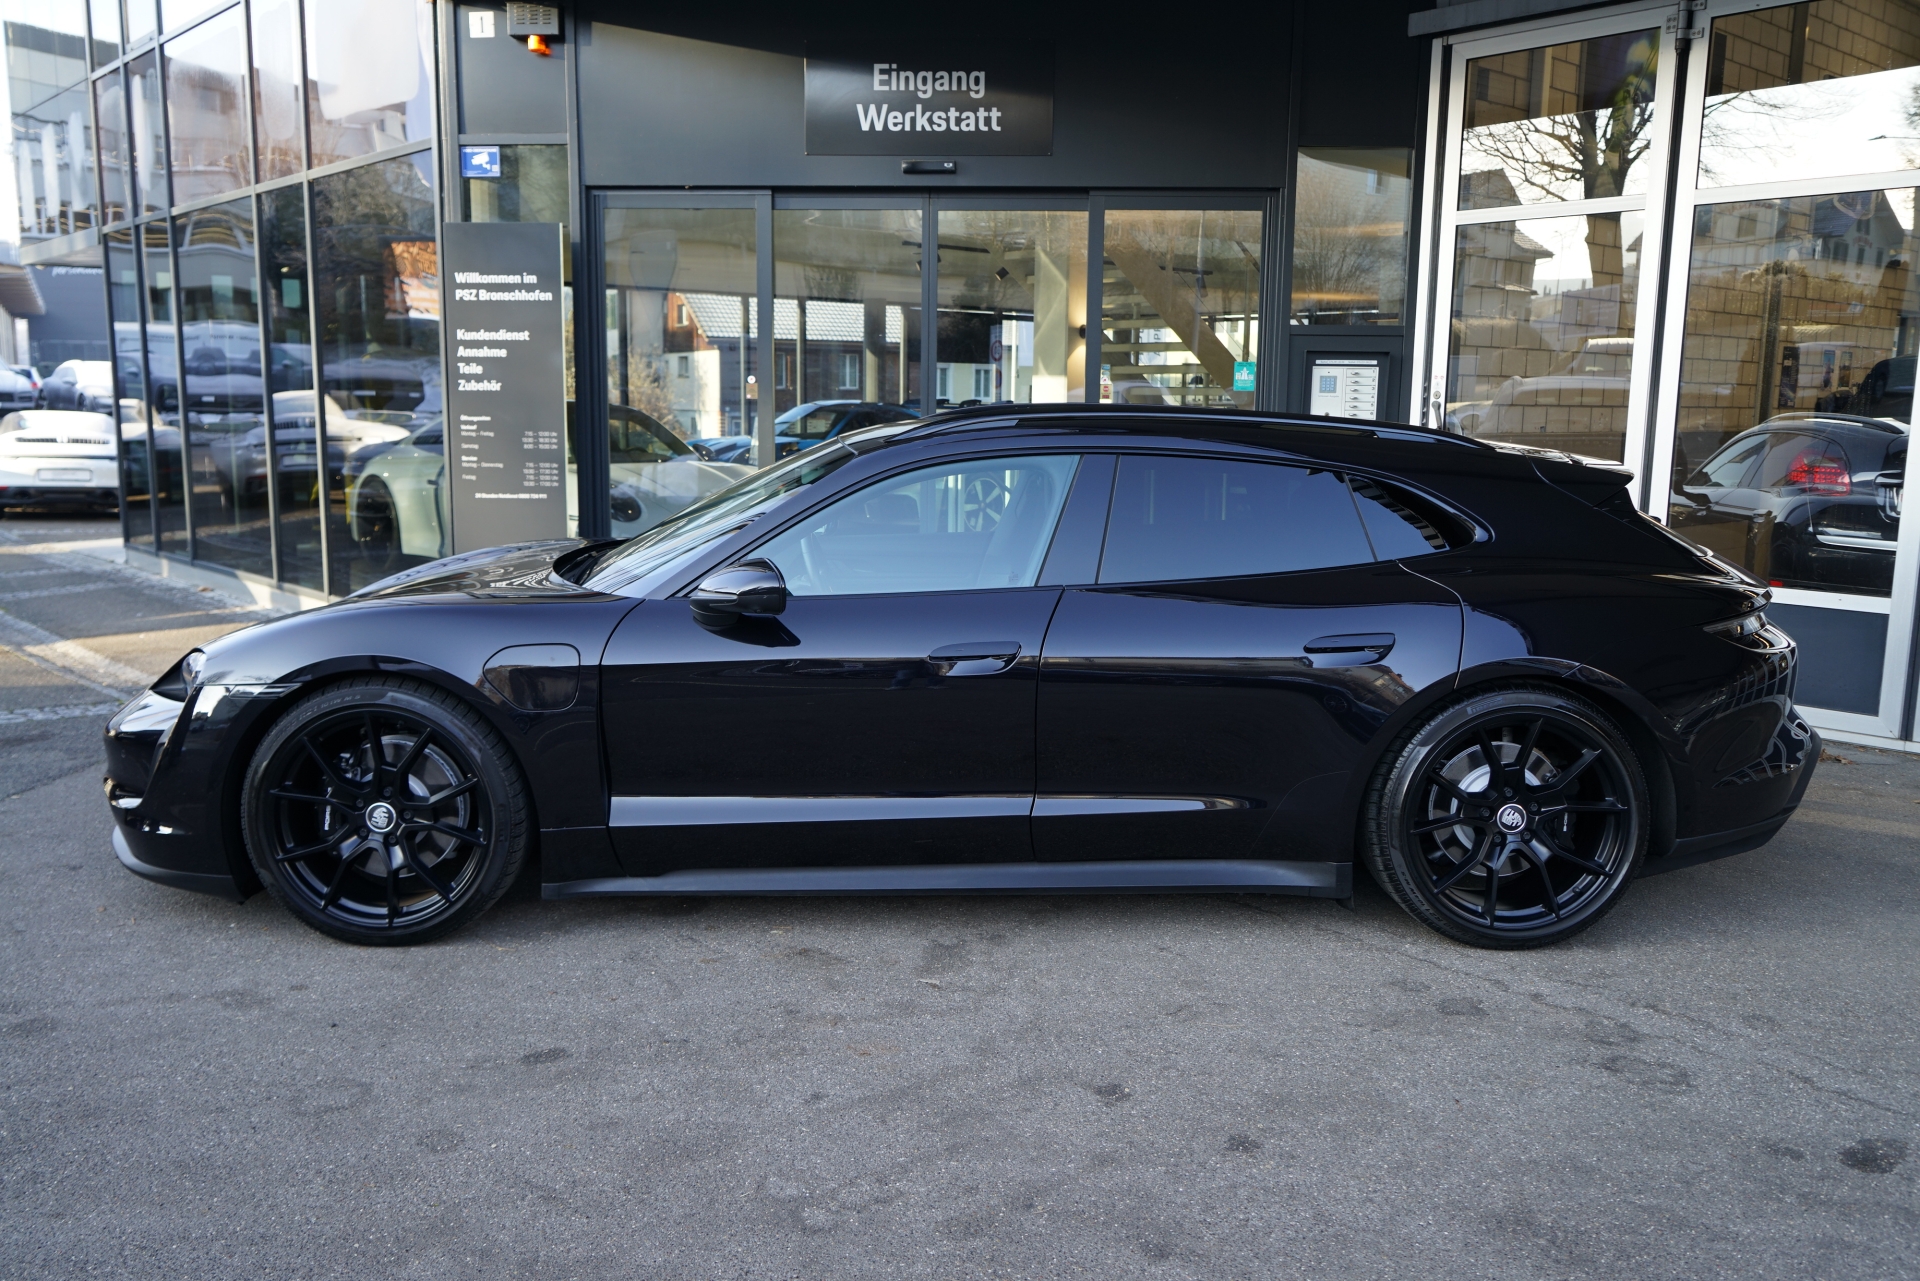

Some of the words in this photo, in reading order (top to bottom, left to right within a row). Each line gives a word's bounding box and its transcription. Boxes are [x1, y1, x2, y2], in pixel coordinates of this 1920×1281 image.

[873, 63, 986, 99] Eingang
[856, 103, 1002, 132] Werkstatt
[454, 272, 522, 284] Willkommen
[522, 272, 538, 284] im
[455, 289, 478, 301] PSZ
[478, 289, 552, 301] Bronschhofen
[456, 329, 530, 340] Kundendienst
[456, 346, 508, 358] Annahme
[457, 362, 483, 374] Teile
[458, 380, 502, 391] Zubehör
